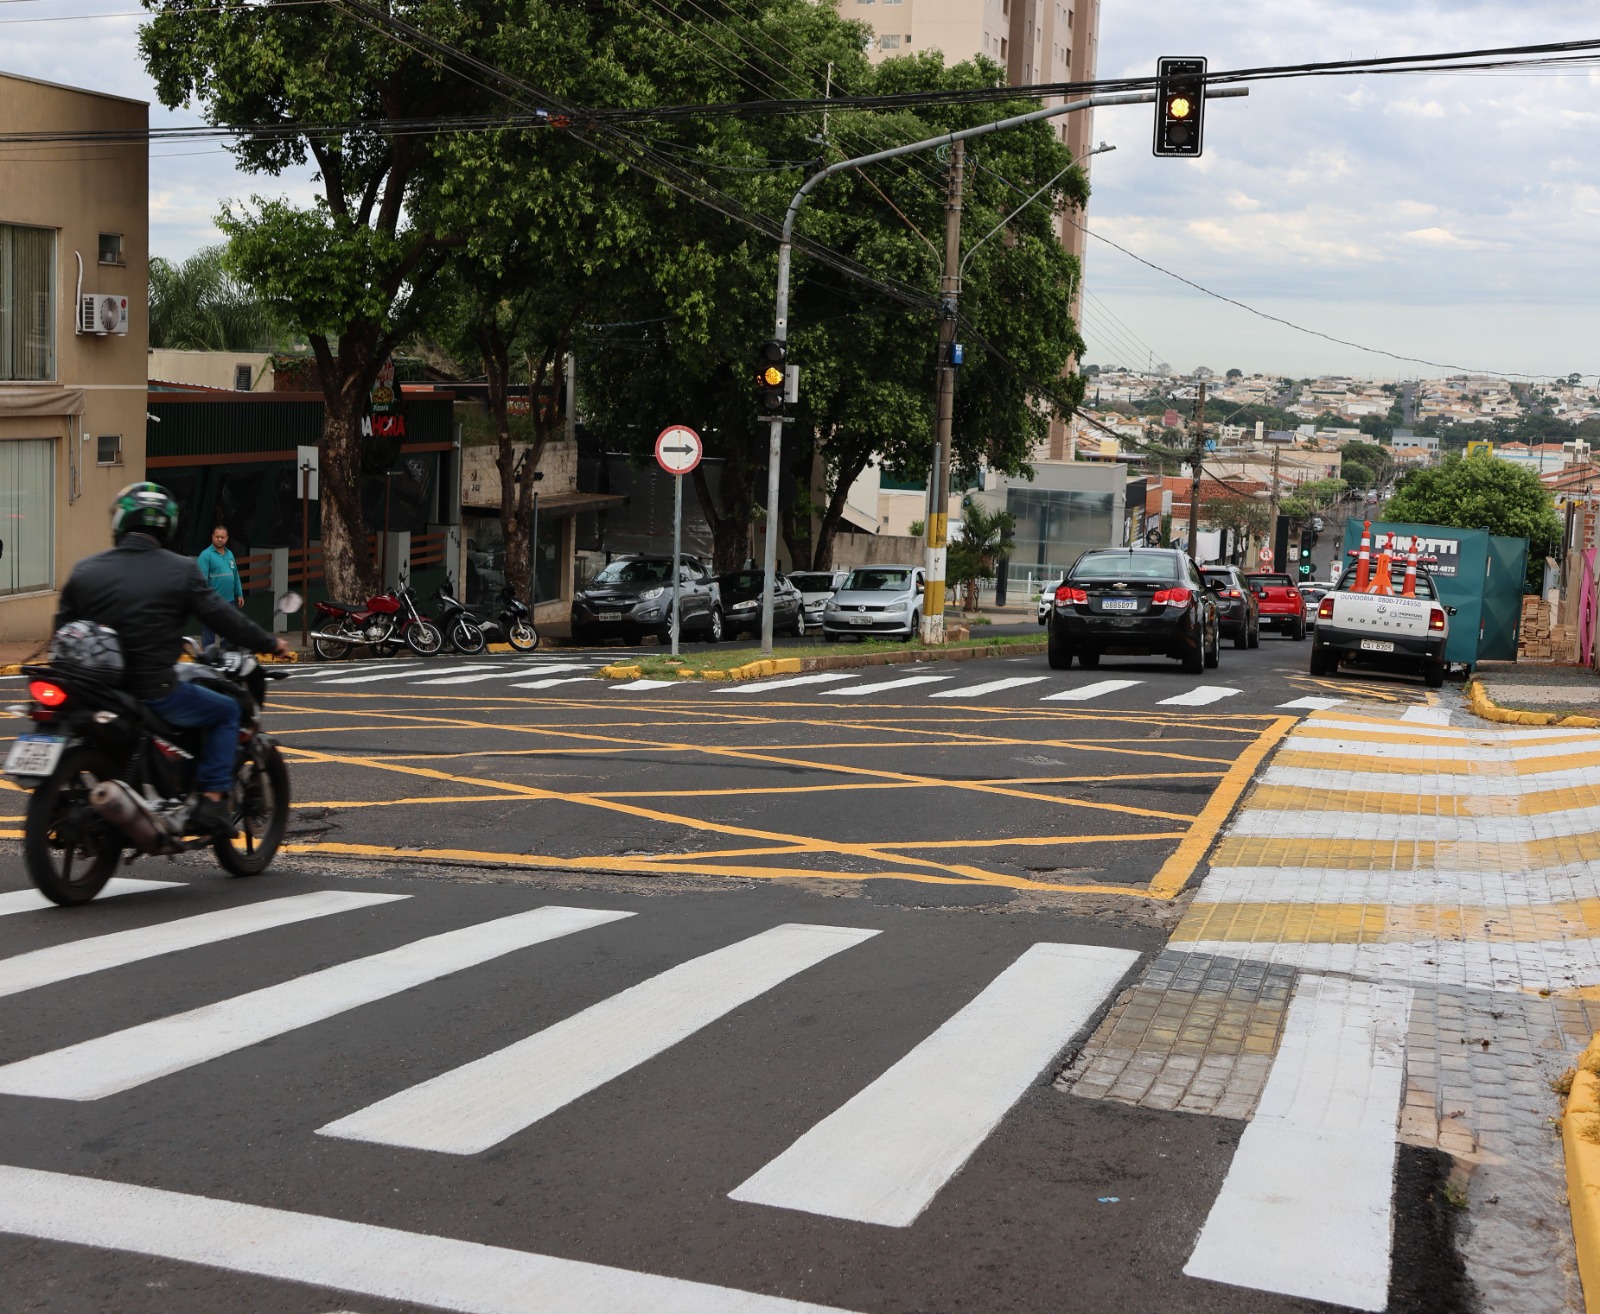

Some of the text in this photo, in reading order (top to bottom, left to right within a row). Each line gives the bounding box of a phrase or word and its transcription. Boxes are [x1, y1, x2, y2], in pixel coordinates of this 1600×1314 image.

[1374, 534, 1458, 555] PINOTTI
[1299, 565, 1310, 574] 43
[1340, 594, 1374, 602] OUVIDORIA
[1347, 617, 1413, 628] ROBUST
